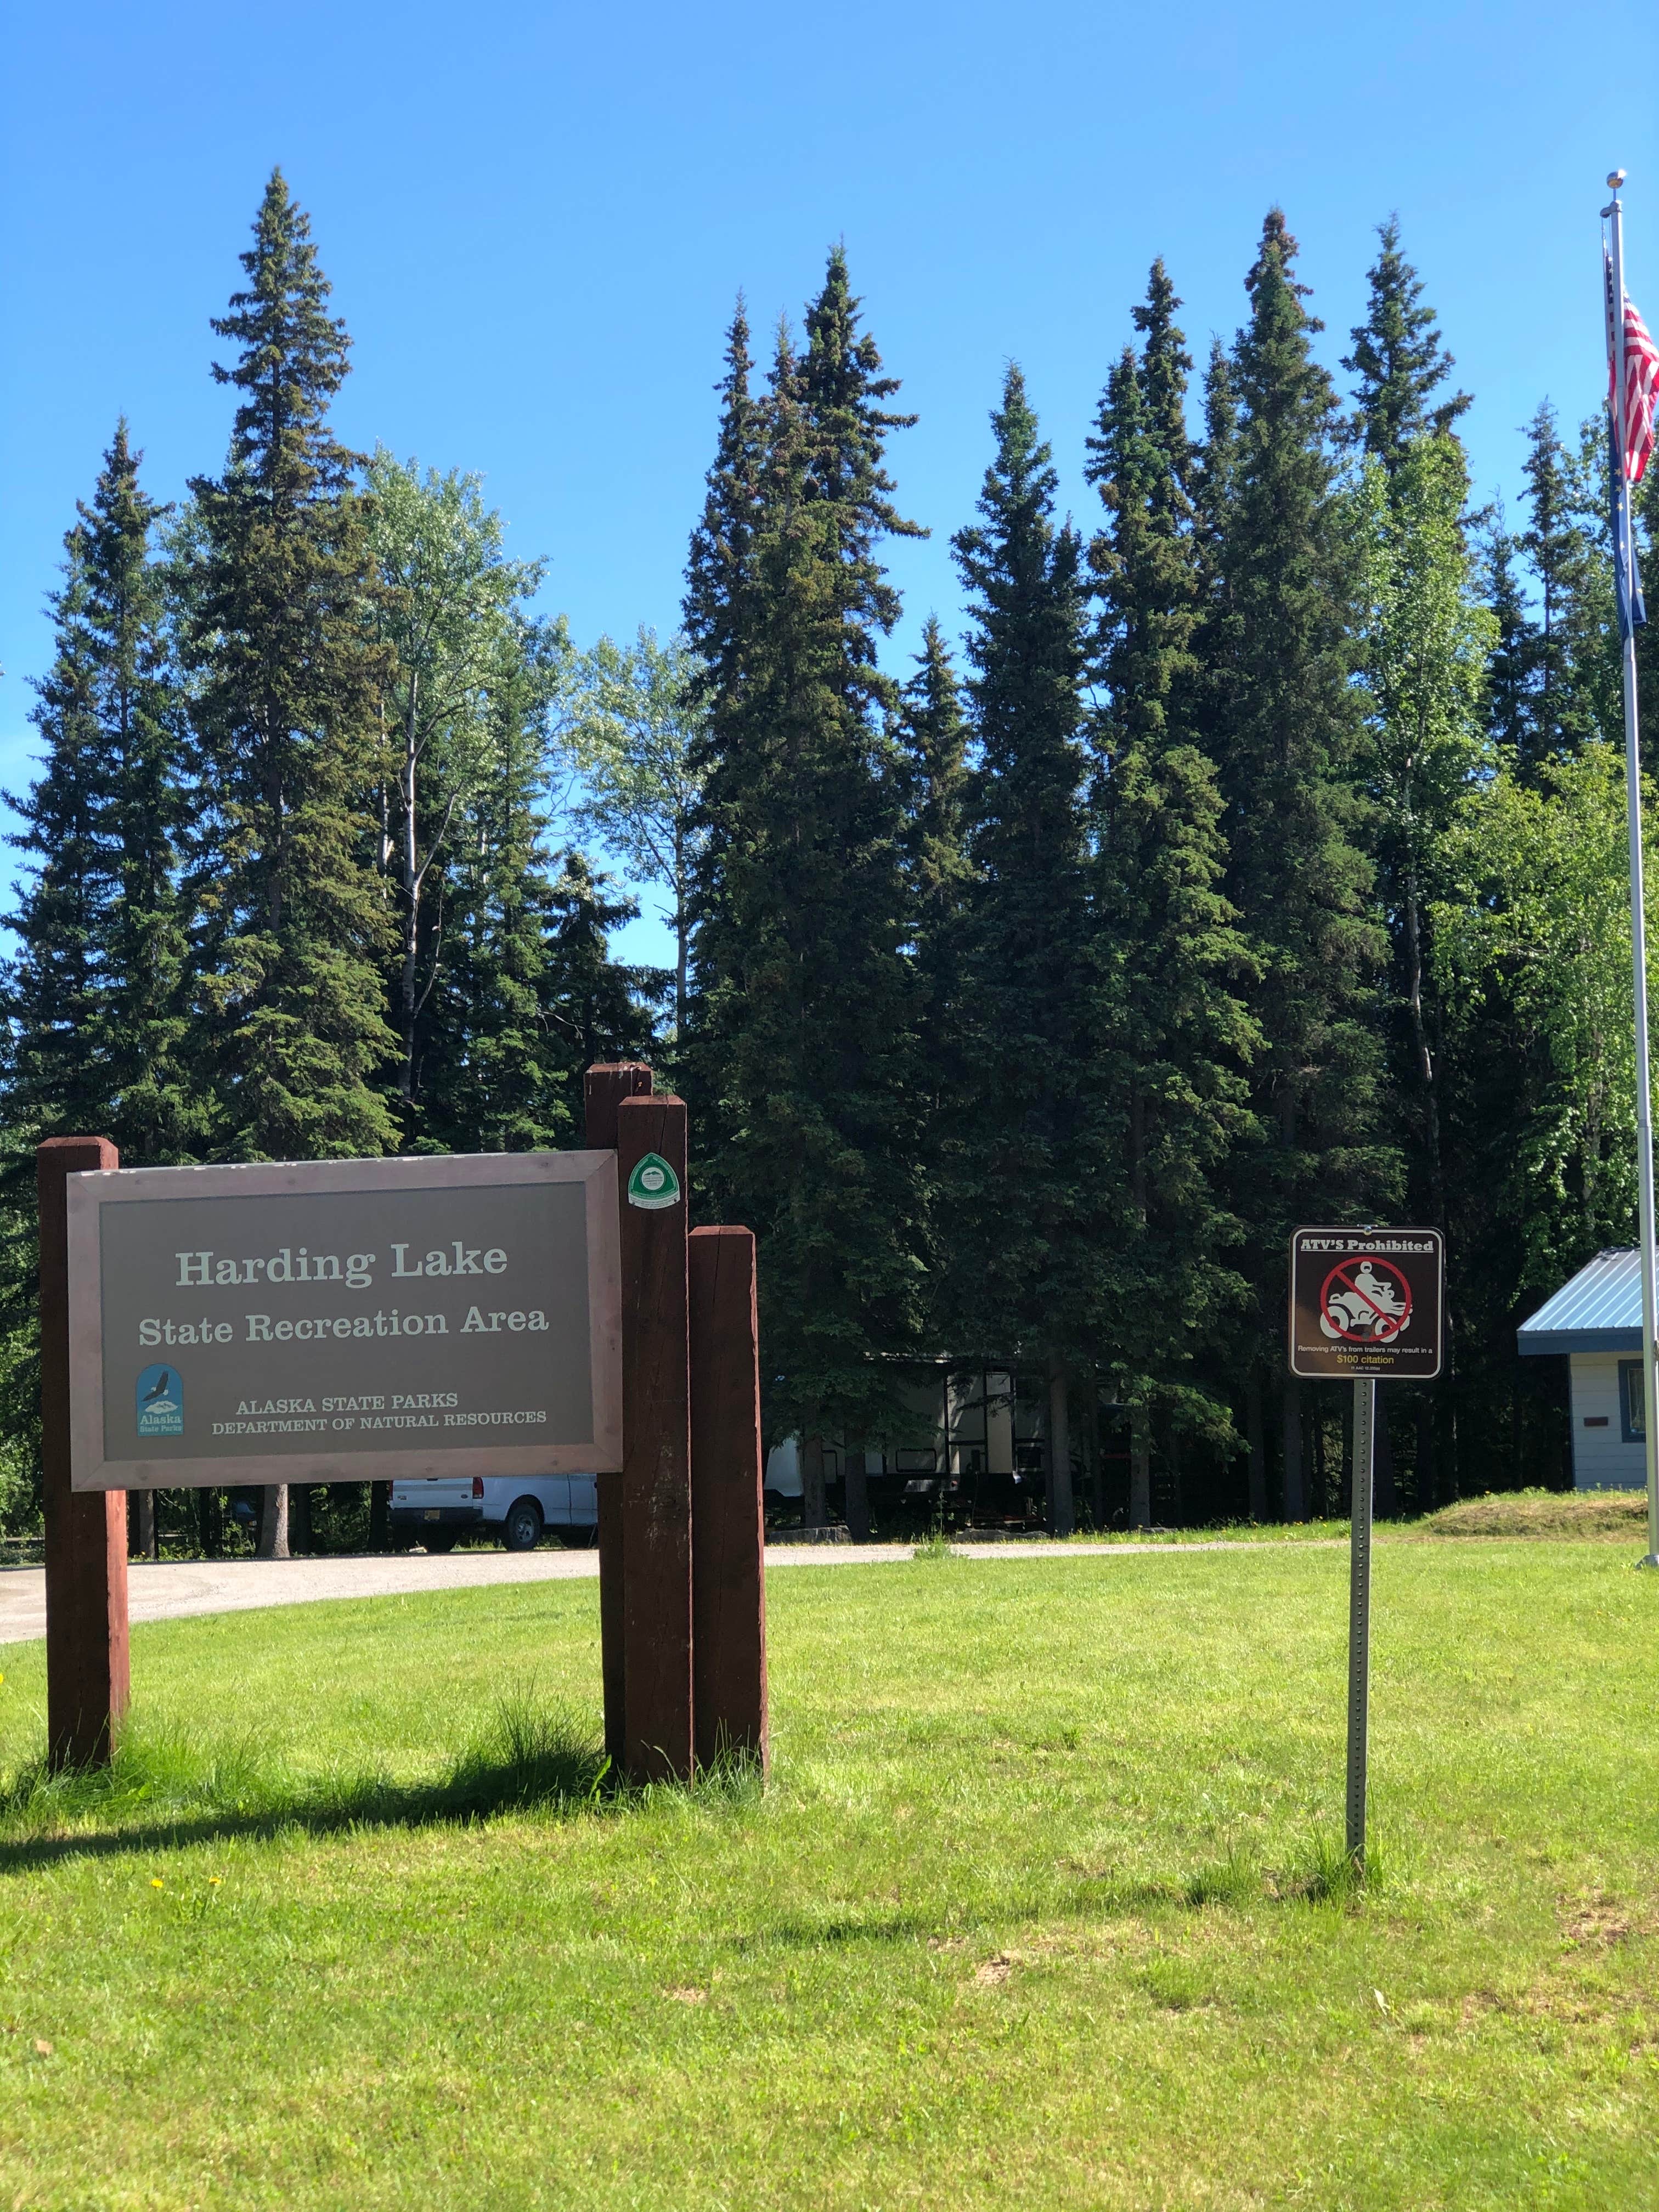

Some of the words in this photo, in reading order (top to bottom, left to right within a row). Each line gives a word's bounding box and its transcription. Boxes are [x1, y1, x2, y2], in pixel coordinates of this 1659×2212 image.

[1301, 1239, 1344, 1250] ATV'S
[1347, 1240, 1434, 1251] Prohibited
[175, 1247, 376, 1289] Harding
[391, 1241, 507, 1278] Lake
[139, 1318, 233, 1346] State
[245, 1309, 449, 1341] Recreation
[460, 1306, 549, 1334] Area
[1336, 1355, 1358, 1364] $100
[1361, 1356, 1394, 1364] citation
[236, 1398, 317, 1415] ALASKA
[322, 1396, 385, 1412] STATE
[392, 1393, 458, 1409] PARKS
[140, 1414, 181, 1425] Alaska
[212, 1419, 328, 1435] DEPARTMENT
[332, 1418, 355, 1430] OF
[360, 1415, 439, 1430] NATURAL
[443, 1411, 547, 1426] RESOURCES
